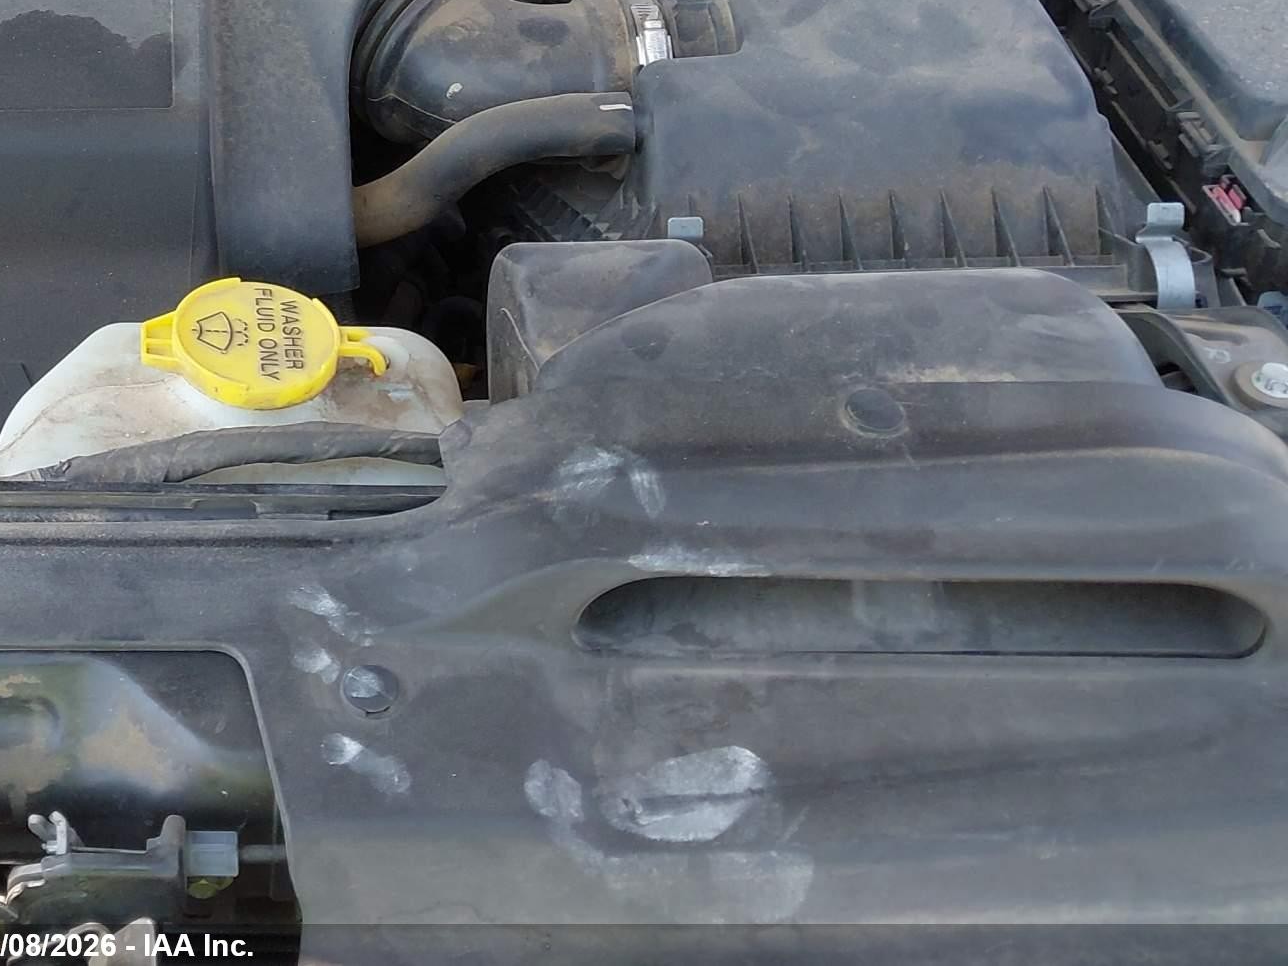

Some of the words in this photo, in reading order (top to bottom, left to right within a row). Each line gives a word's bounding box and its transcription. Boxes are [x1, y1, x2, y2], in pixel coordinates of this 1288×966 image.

[254, 288, 275, 333] FLUID
[280, 300, 304, 370] WASHER
[257, 337, 281, 381] ONLY
